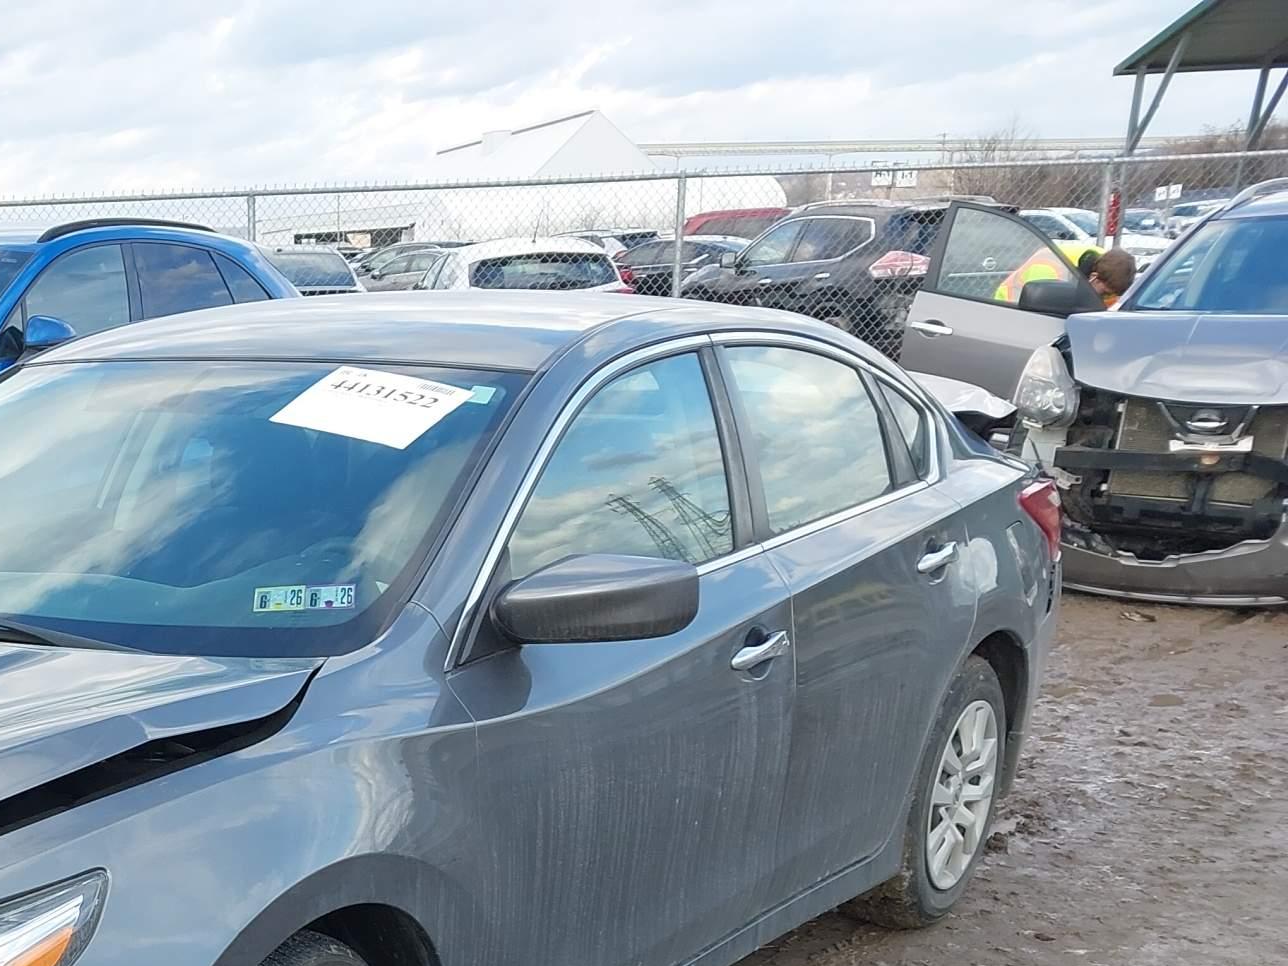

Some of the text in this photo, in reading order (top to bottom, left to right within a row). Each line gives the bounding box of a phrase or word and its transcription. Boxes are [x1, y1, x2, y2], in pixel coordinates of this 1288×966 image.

[330, 379, 440, 409] 44131522
[259, 588, 303, 609] 6 26
[309, 587, 353, 608] 6 26
